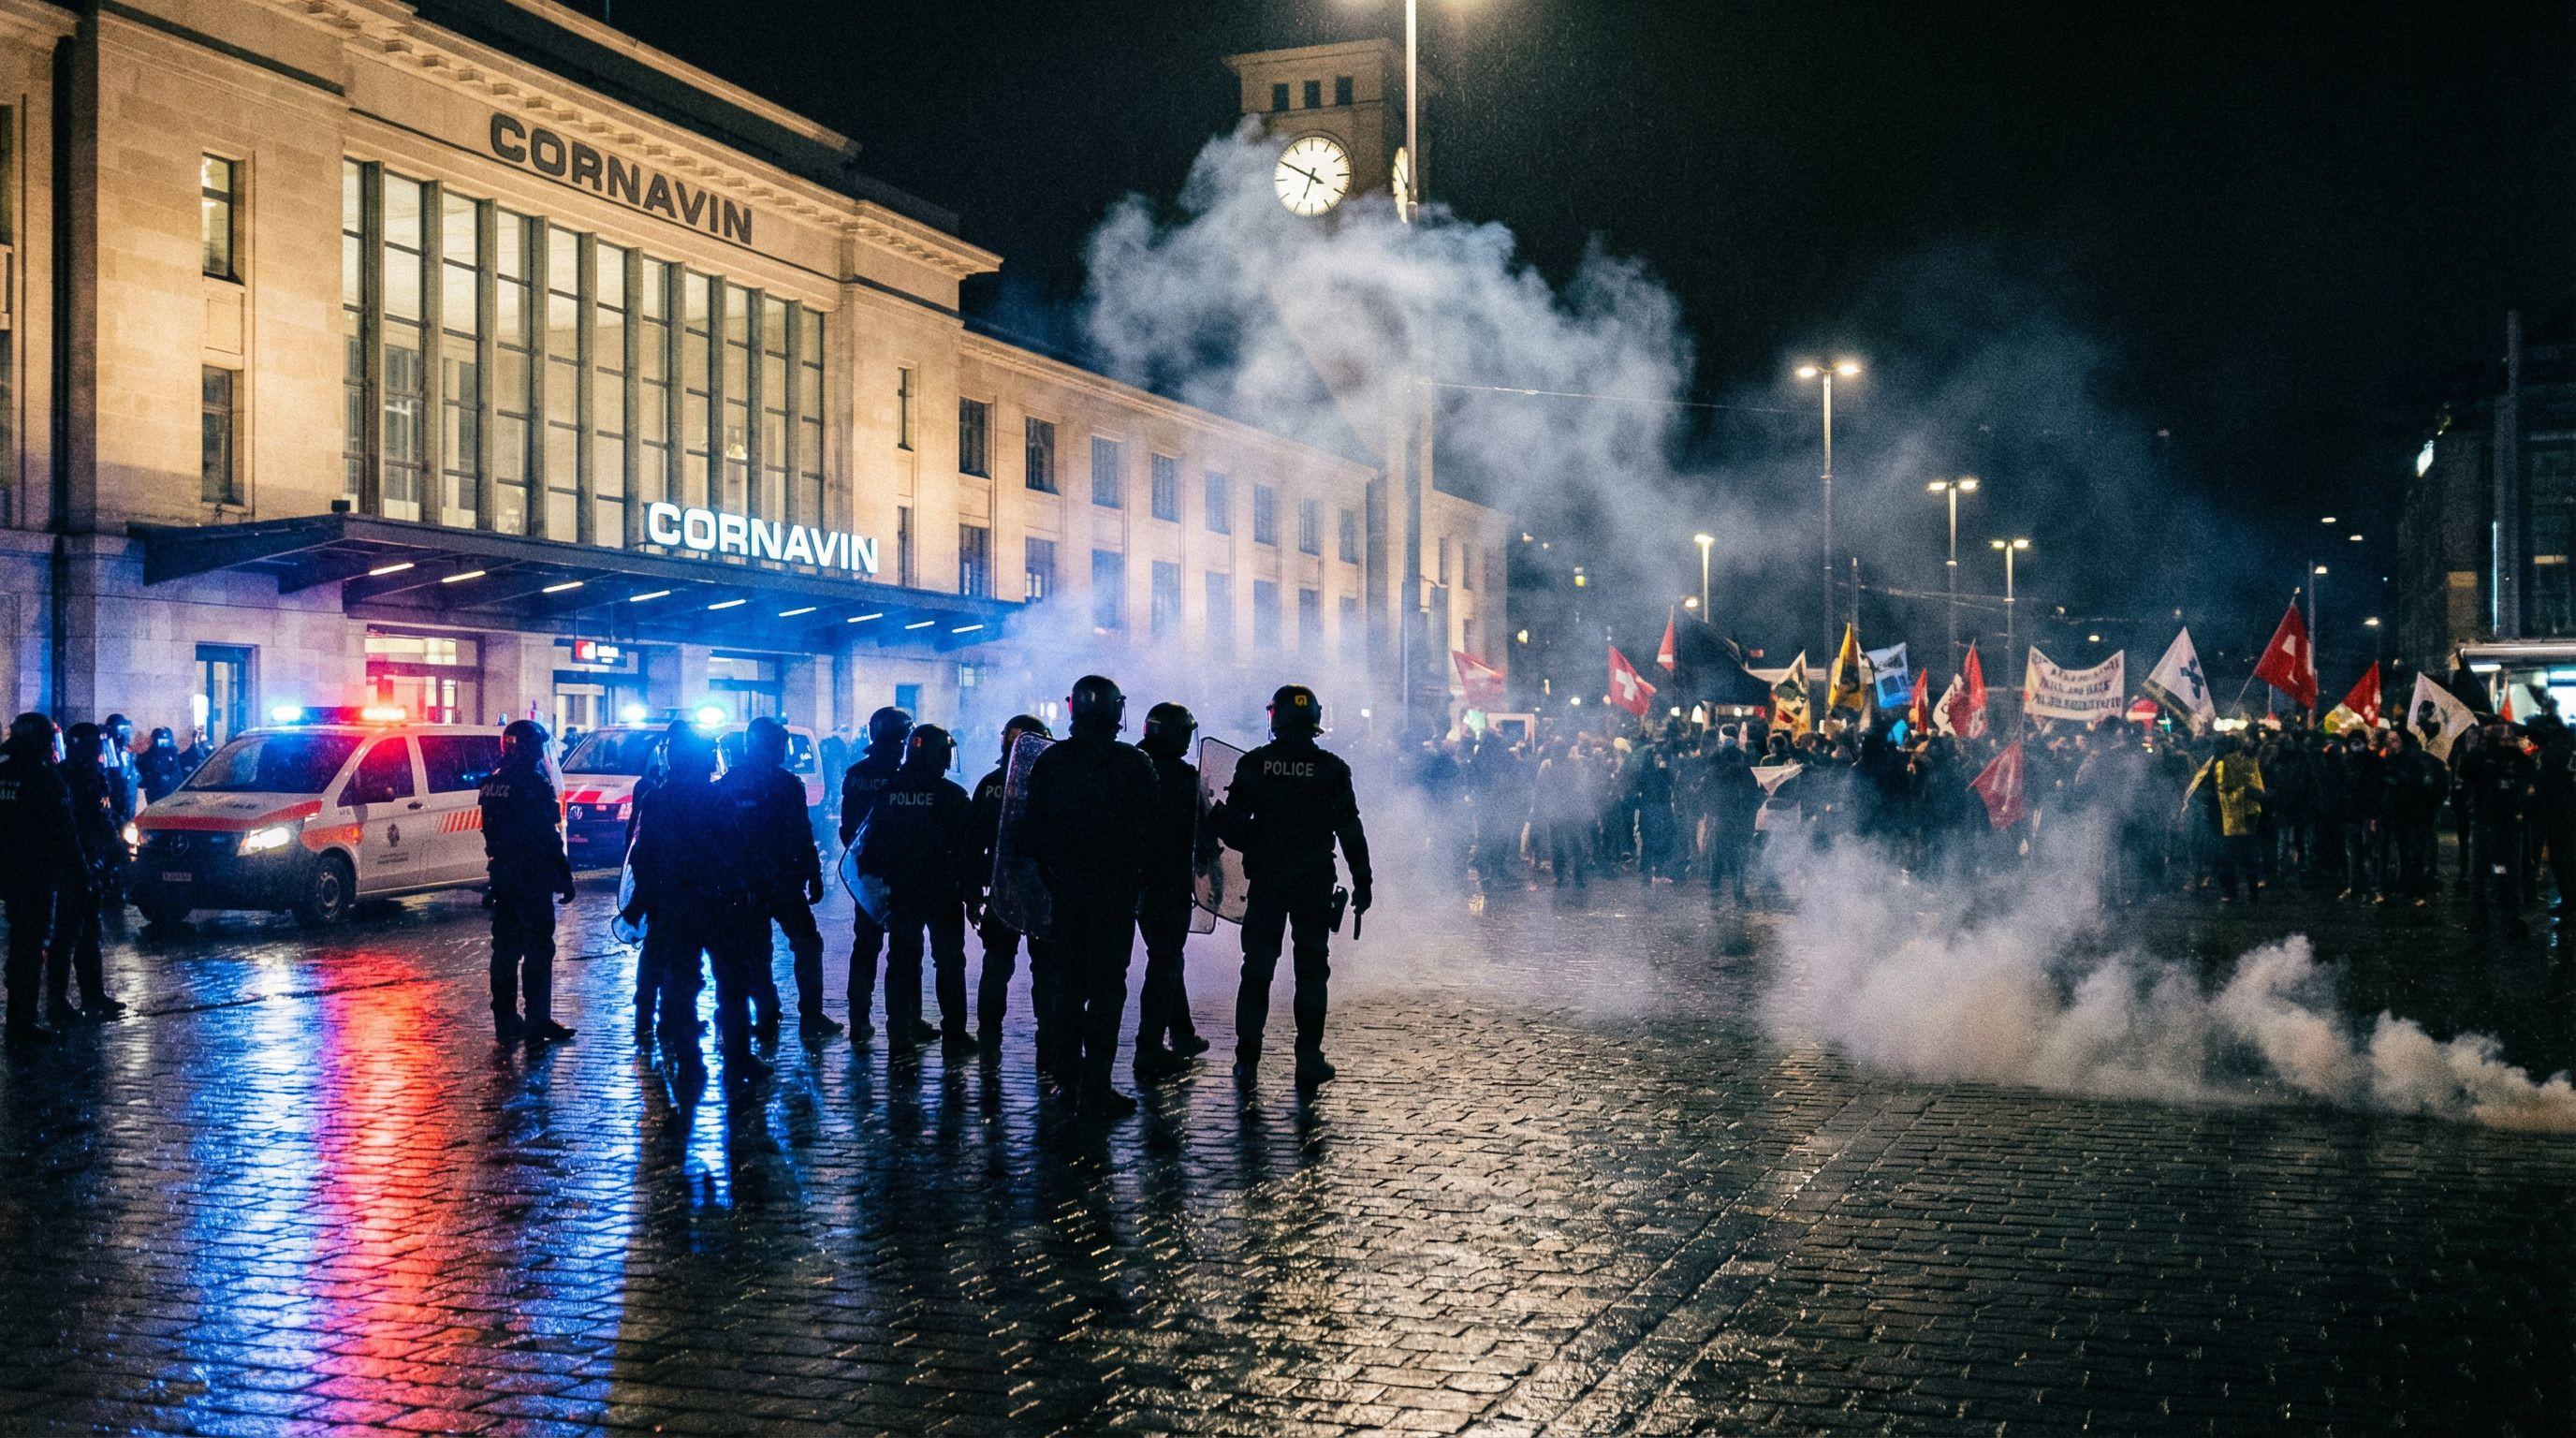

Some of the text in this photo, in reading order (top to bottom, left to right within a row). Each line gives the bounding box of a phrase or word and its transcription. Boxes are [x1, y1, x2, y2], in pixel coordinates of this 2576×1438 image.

[490, 111, 752, 245] CORNAVIN
[649, 502, 879, 573] CORNAVIN
[1264, 760, 1314, 776] POLICE
[889, 792, 934, 806] POLICE
[986, 785, 1003, 799] PO
